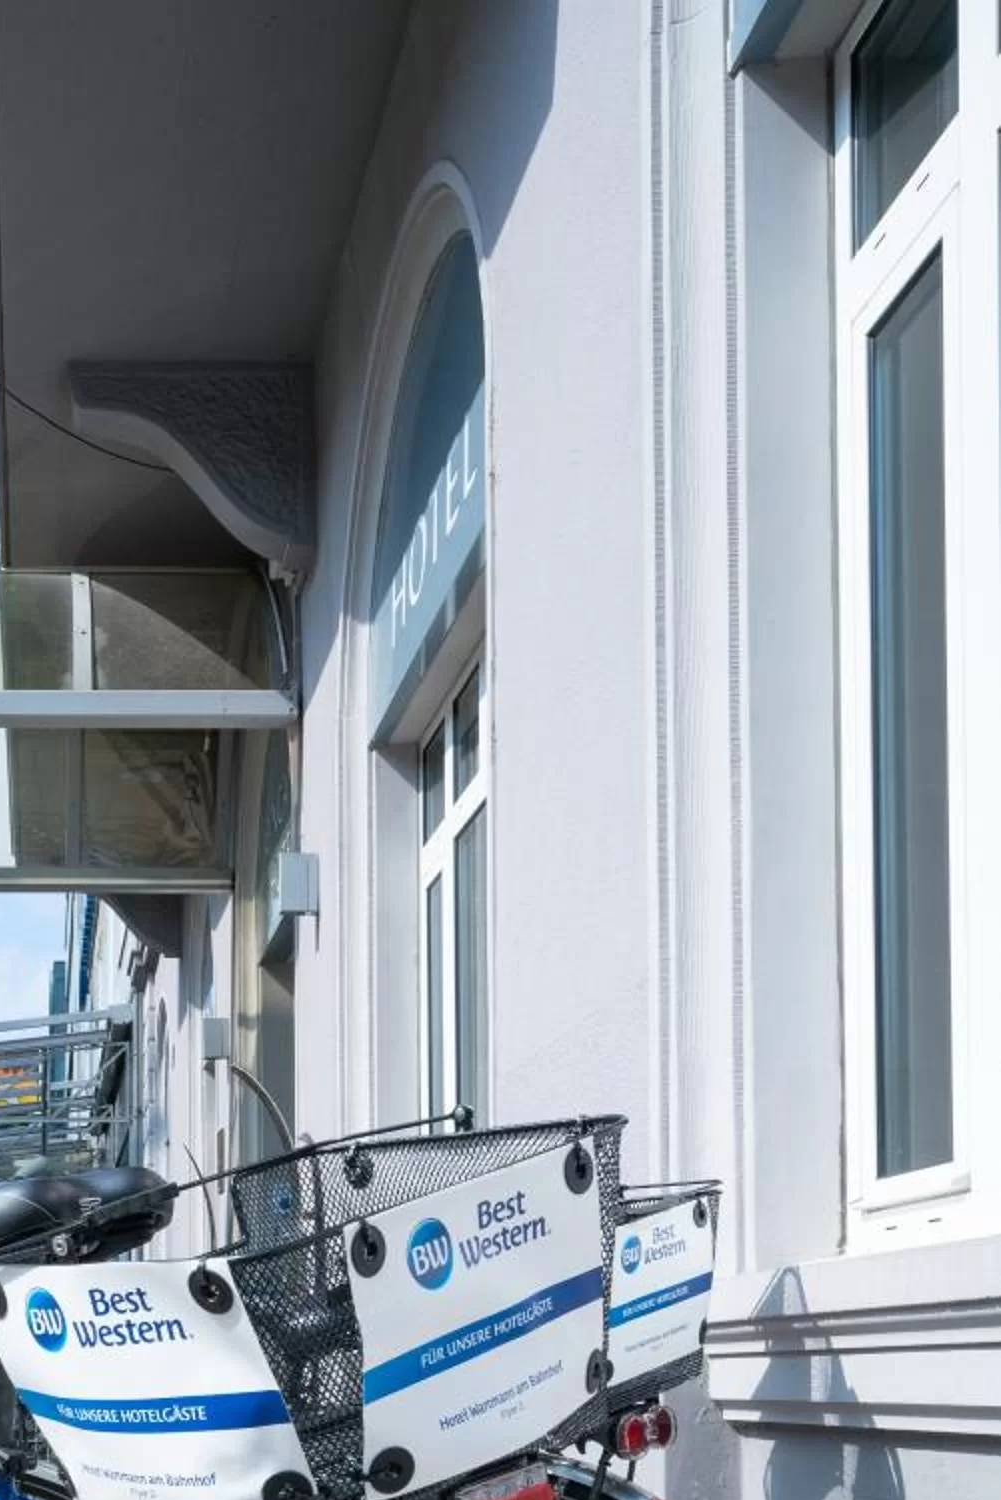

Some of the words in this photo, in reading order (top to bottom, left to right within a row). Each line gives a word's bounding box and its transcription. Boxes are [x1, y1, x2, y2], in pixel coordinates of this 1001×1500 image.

[390, 416, 478, 648] HOTEL
[477, 1190, 526, 1229] Best
[411, 1235, 449, 1276] BW
[89, 1287, 152, 1317] Best
[29, 1308, 62, 1336] BW
[420, 1347, 446, 1368] FÜR
[446, 1326, 492, 1356] UNSERE
[493, 1297, 554, 1336] HOTELGÄSTE
[121, 1404, 208, 1423] HOTELGÄSTE
